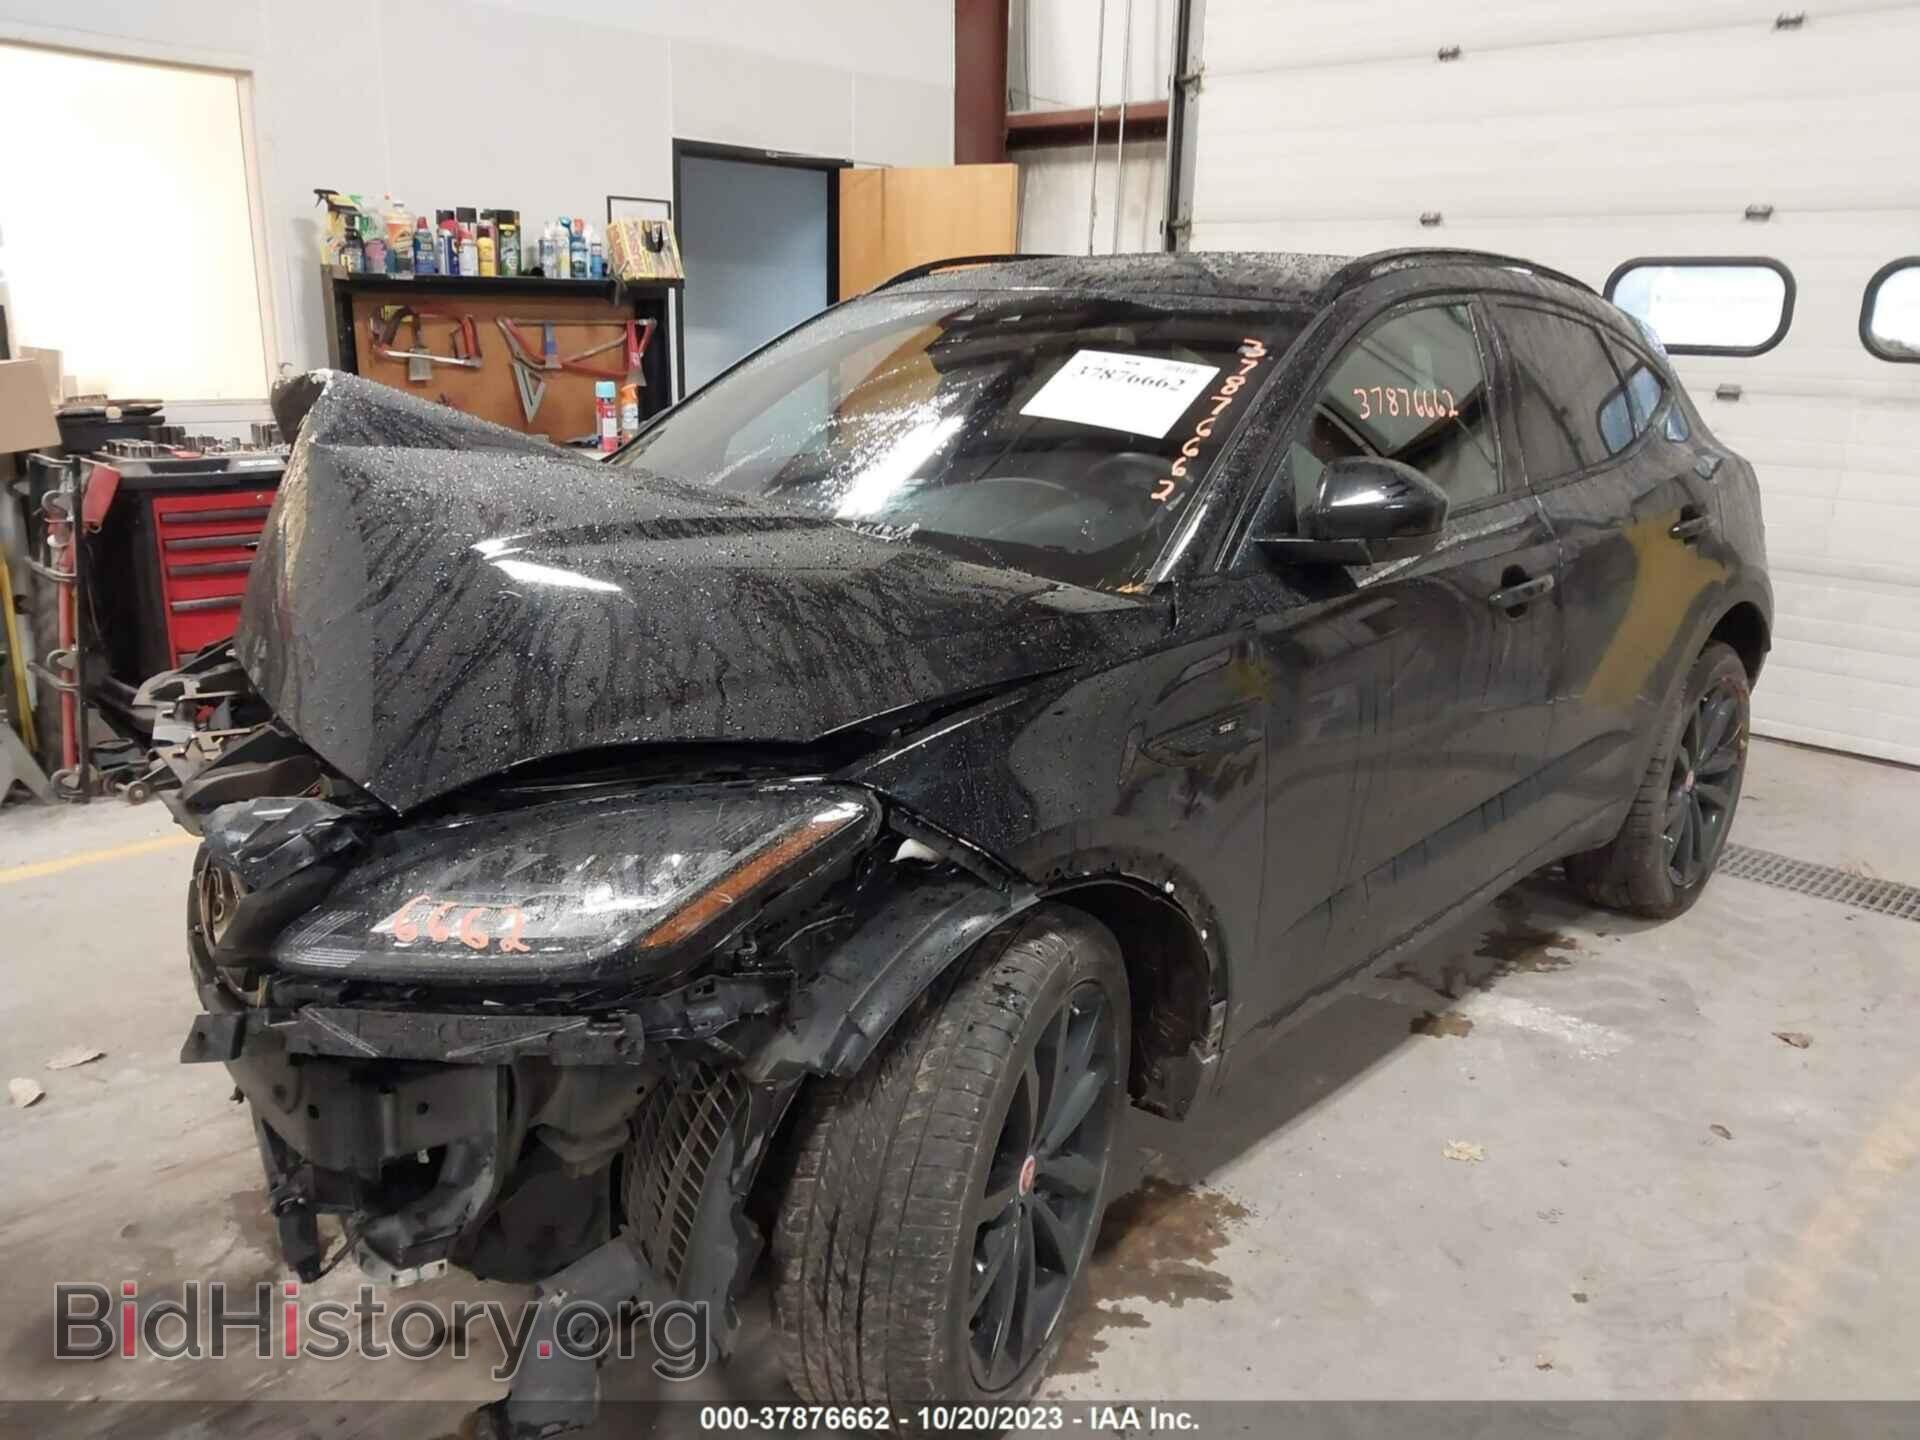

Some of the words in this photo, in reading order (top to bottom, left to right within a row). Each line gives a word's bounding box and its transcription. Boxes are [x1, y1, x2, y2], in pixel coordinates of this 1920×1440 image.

[1151, 338, 1265, 501] 37876662
[1353, 386, 1459, 420] 37876662
[393, 894, 531, 953] 6662
